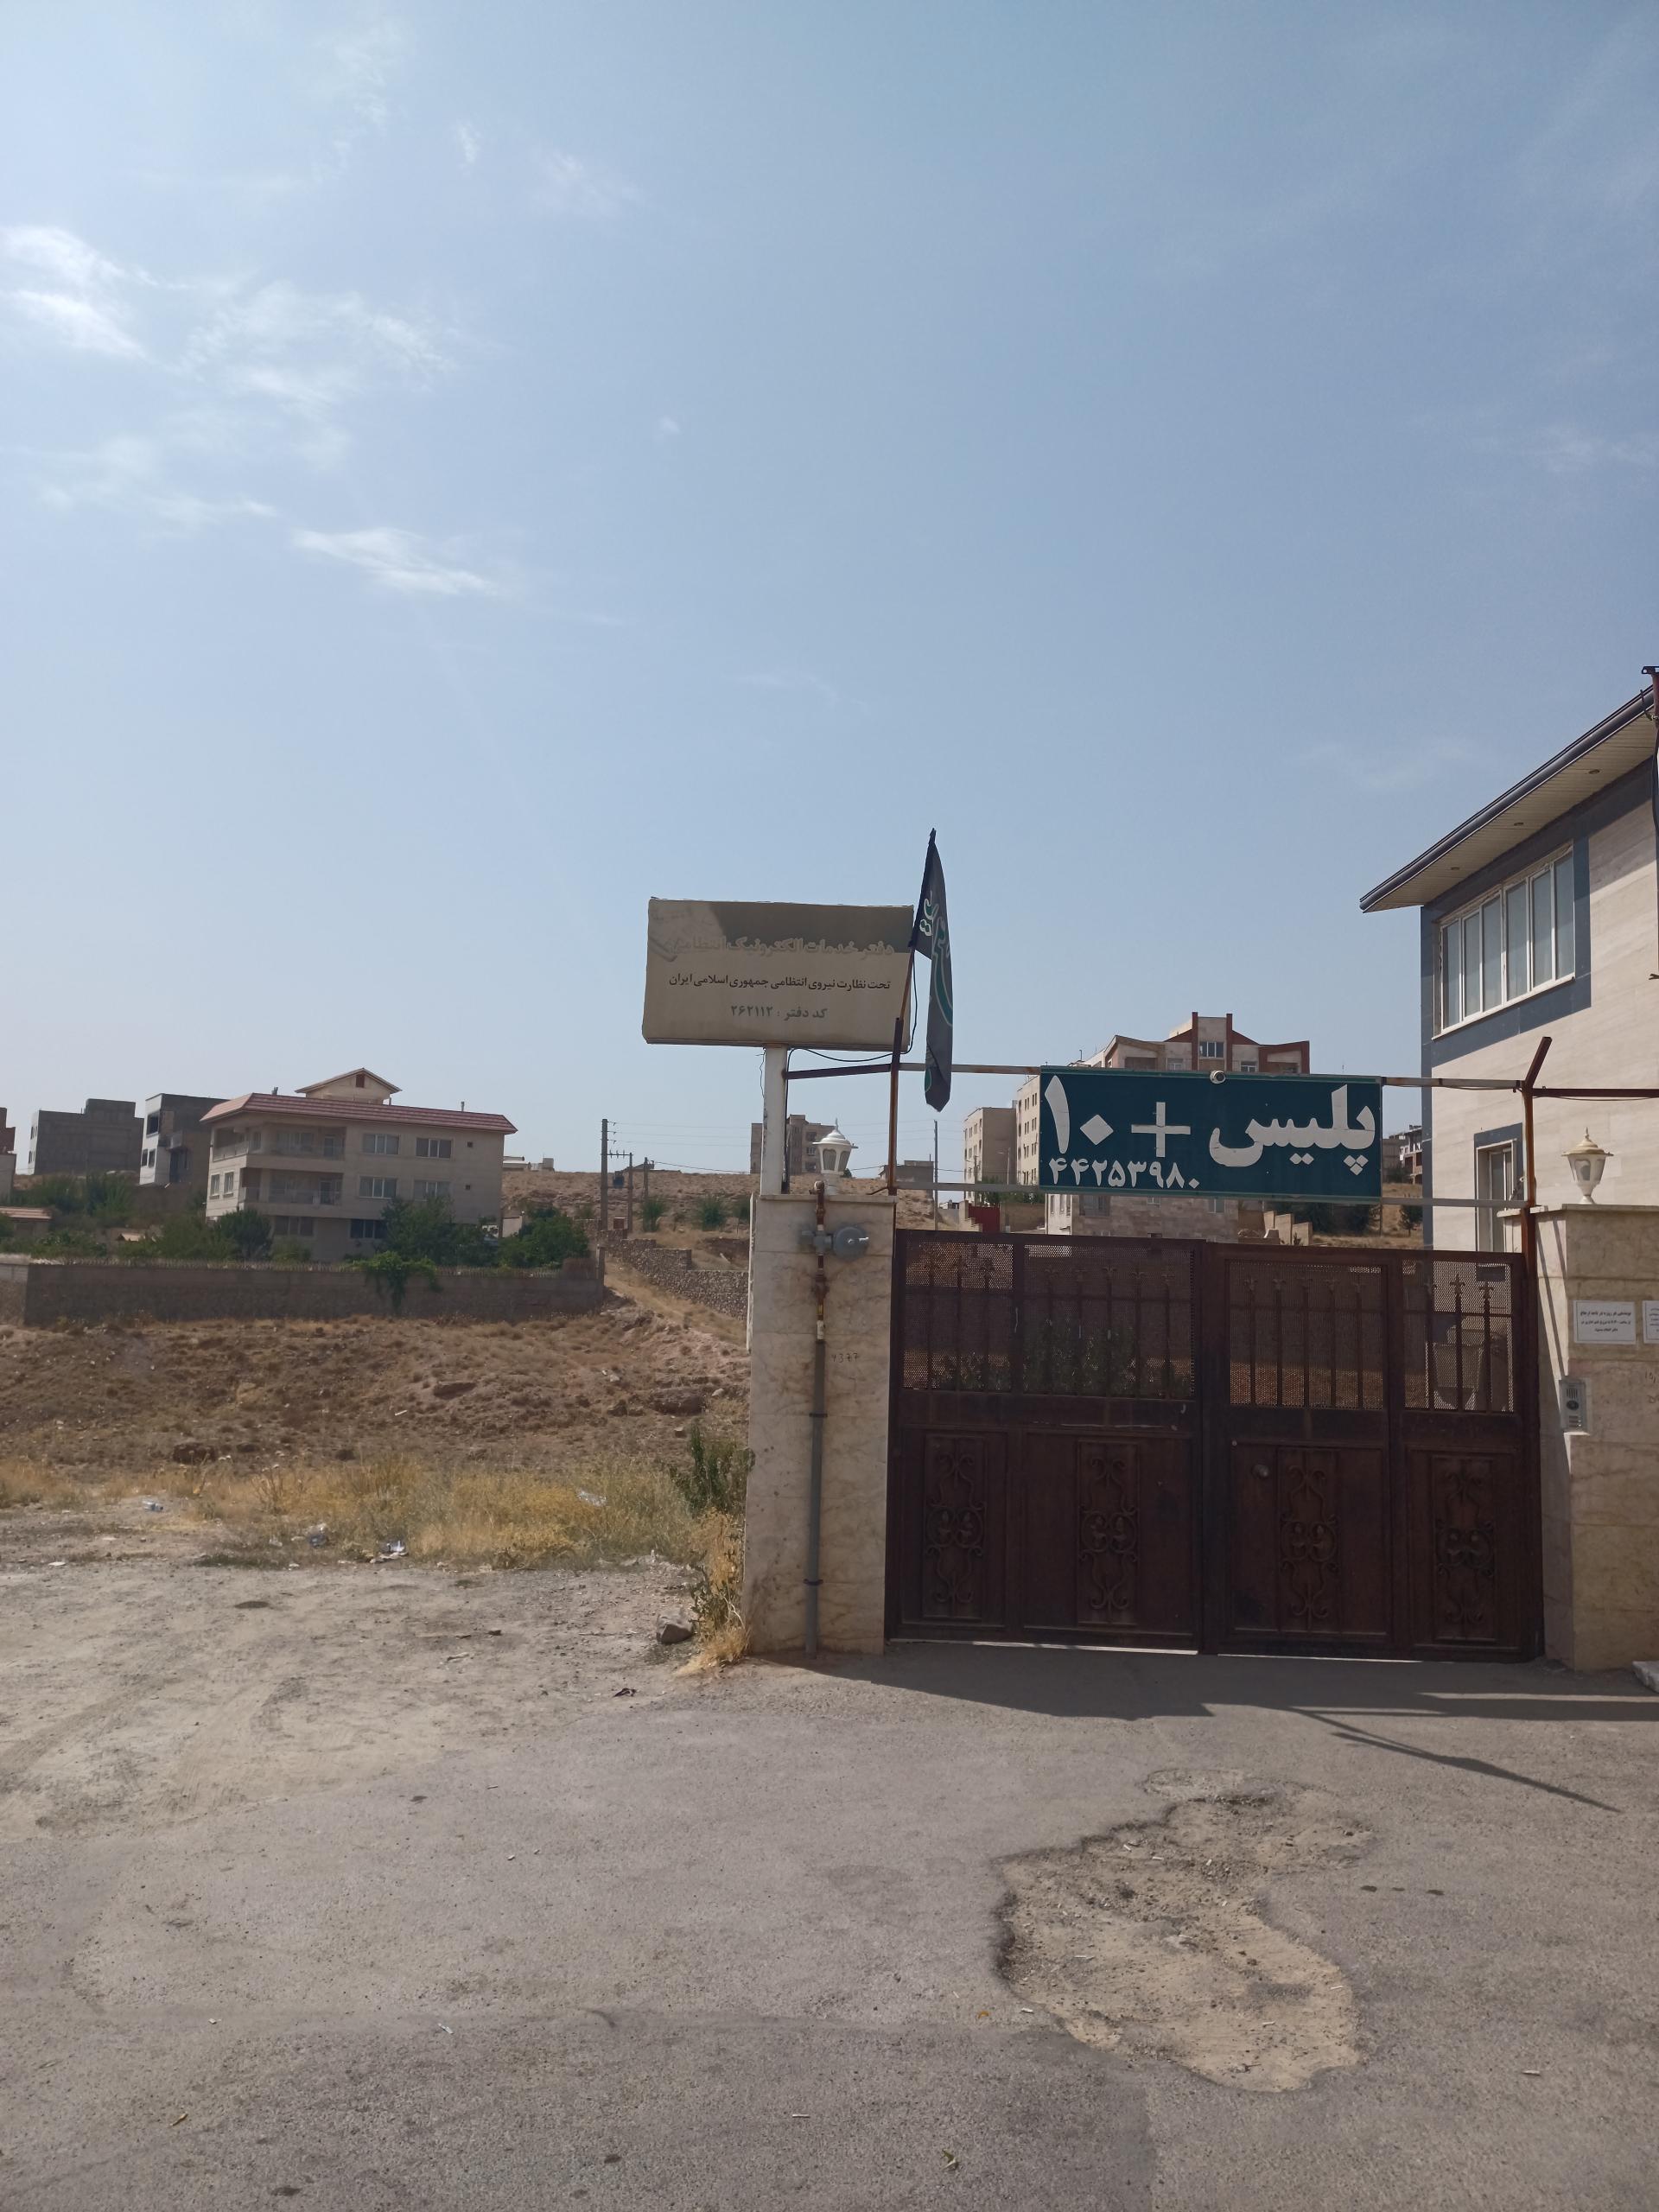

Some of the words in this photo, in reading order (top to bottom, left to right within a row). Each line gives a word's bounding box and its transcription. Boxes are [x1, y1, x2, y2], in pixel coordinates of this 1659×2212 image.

[669, 973, 692, 986] ایران
[693, 974, 728, 987] اسلامی
[729, 977, 769, 988] جمهوری
[771, 976, 807, 990] انتظامی
[808, 978, 836, 991] نیروی
[836, 979, 866, 992] نظارت
[868, 981, 892, 990] تحت
[784, 1006, 810, 1021] دفتر
[812, 1007, 829, 1019] کد
[1210, 1084, 1376, 1176] پلیس
[1048, 1157, 1200, 1189] ۴۴۲۵۳۹۸۰
